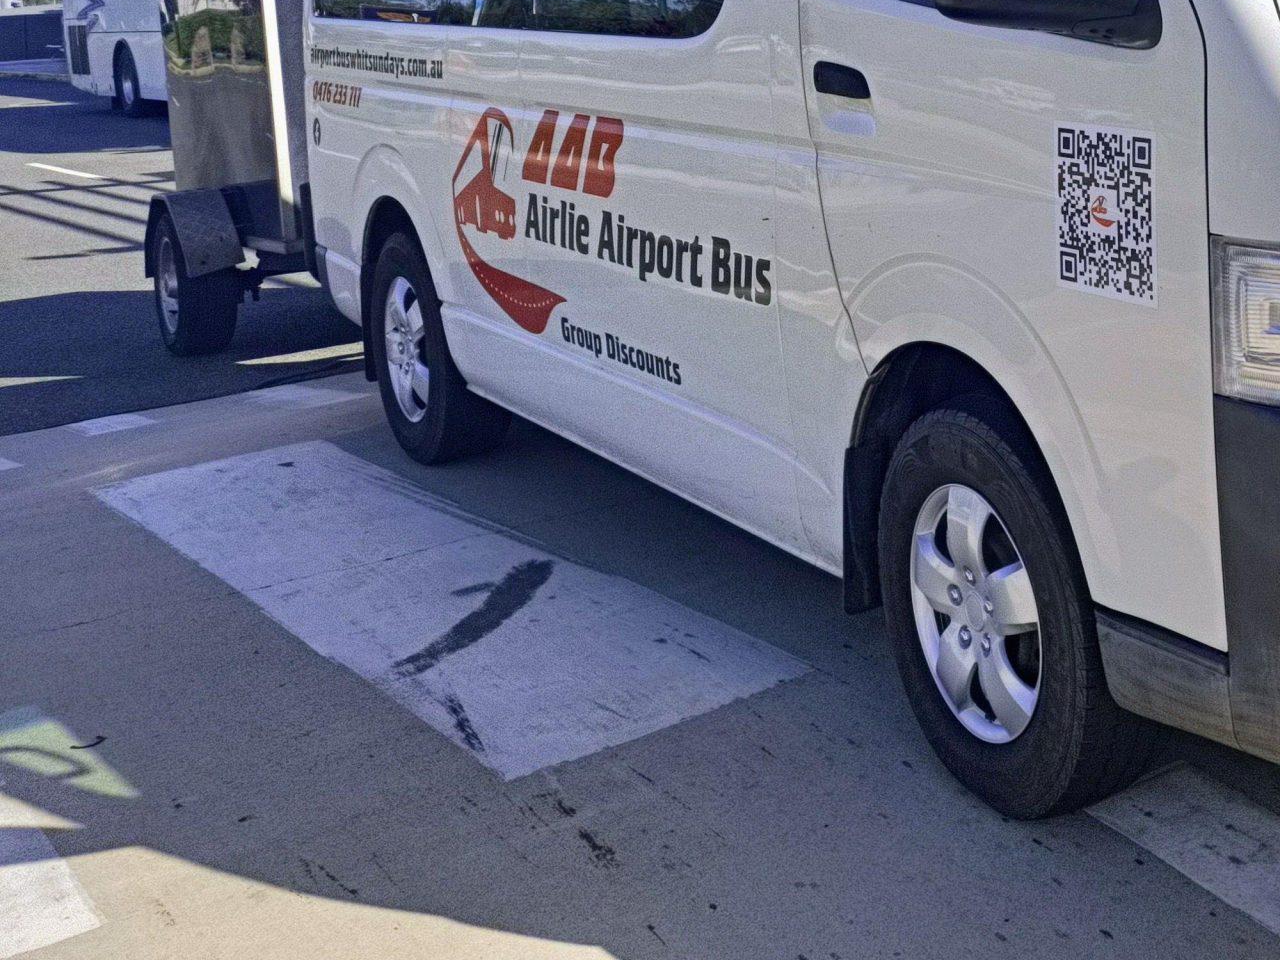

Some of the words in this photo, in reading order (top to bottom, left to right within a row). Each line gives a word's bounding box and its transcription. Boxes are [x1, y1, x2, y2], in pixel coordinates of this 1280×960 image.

[310, 45, 443, 79] airportbuswhitsundays.com.au
[521, 108, 625, 199] AAB
[524, 192, 591, 256] Airlie
[596, 209, 704, 288] Airport
[710, 235, 773, 307] Bus
[560, 316, 603, 359] Group
[605, 332, 682, 387] Discounts
